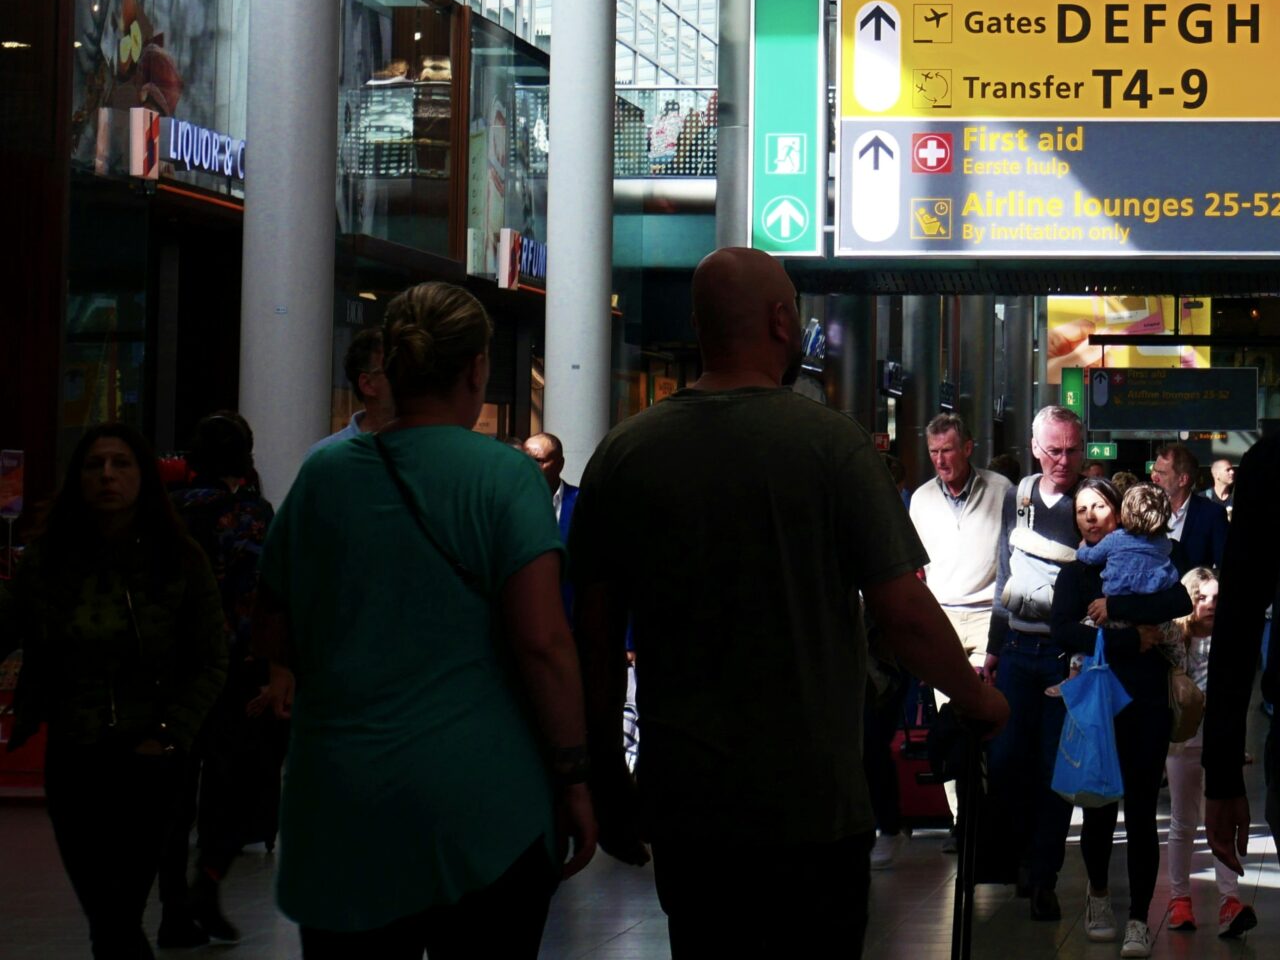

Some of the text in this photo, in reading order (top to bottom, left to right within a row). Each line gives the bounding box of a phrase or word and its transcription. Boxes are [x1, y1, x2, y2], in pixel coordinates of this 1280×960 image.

[964, 10, 1046, 34] Gates
[963, 68, 1208, 110] Transfer T4-9
[169, 118, 220, 172] LIQUOR
[223, 136, 233, 176] &
[962, 126, 1084, 152] First aid
[962, 158, 1070, 179] Eerste hulp
[961, 192, 1063, 217] Airline
[1073, 192, 1194, 223] lounges
[961, 223, 1130, 245] By invitation only
